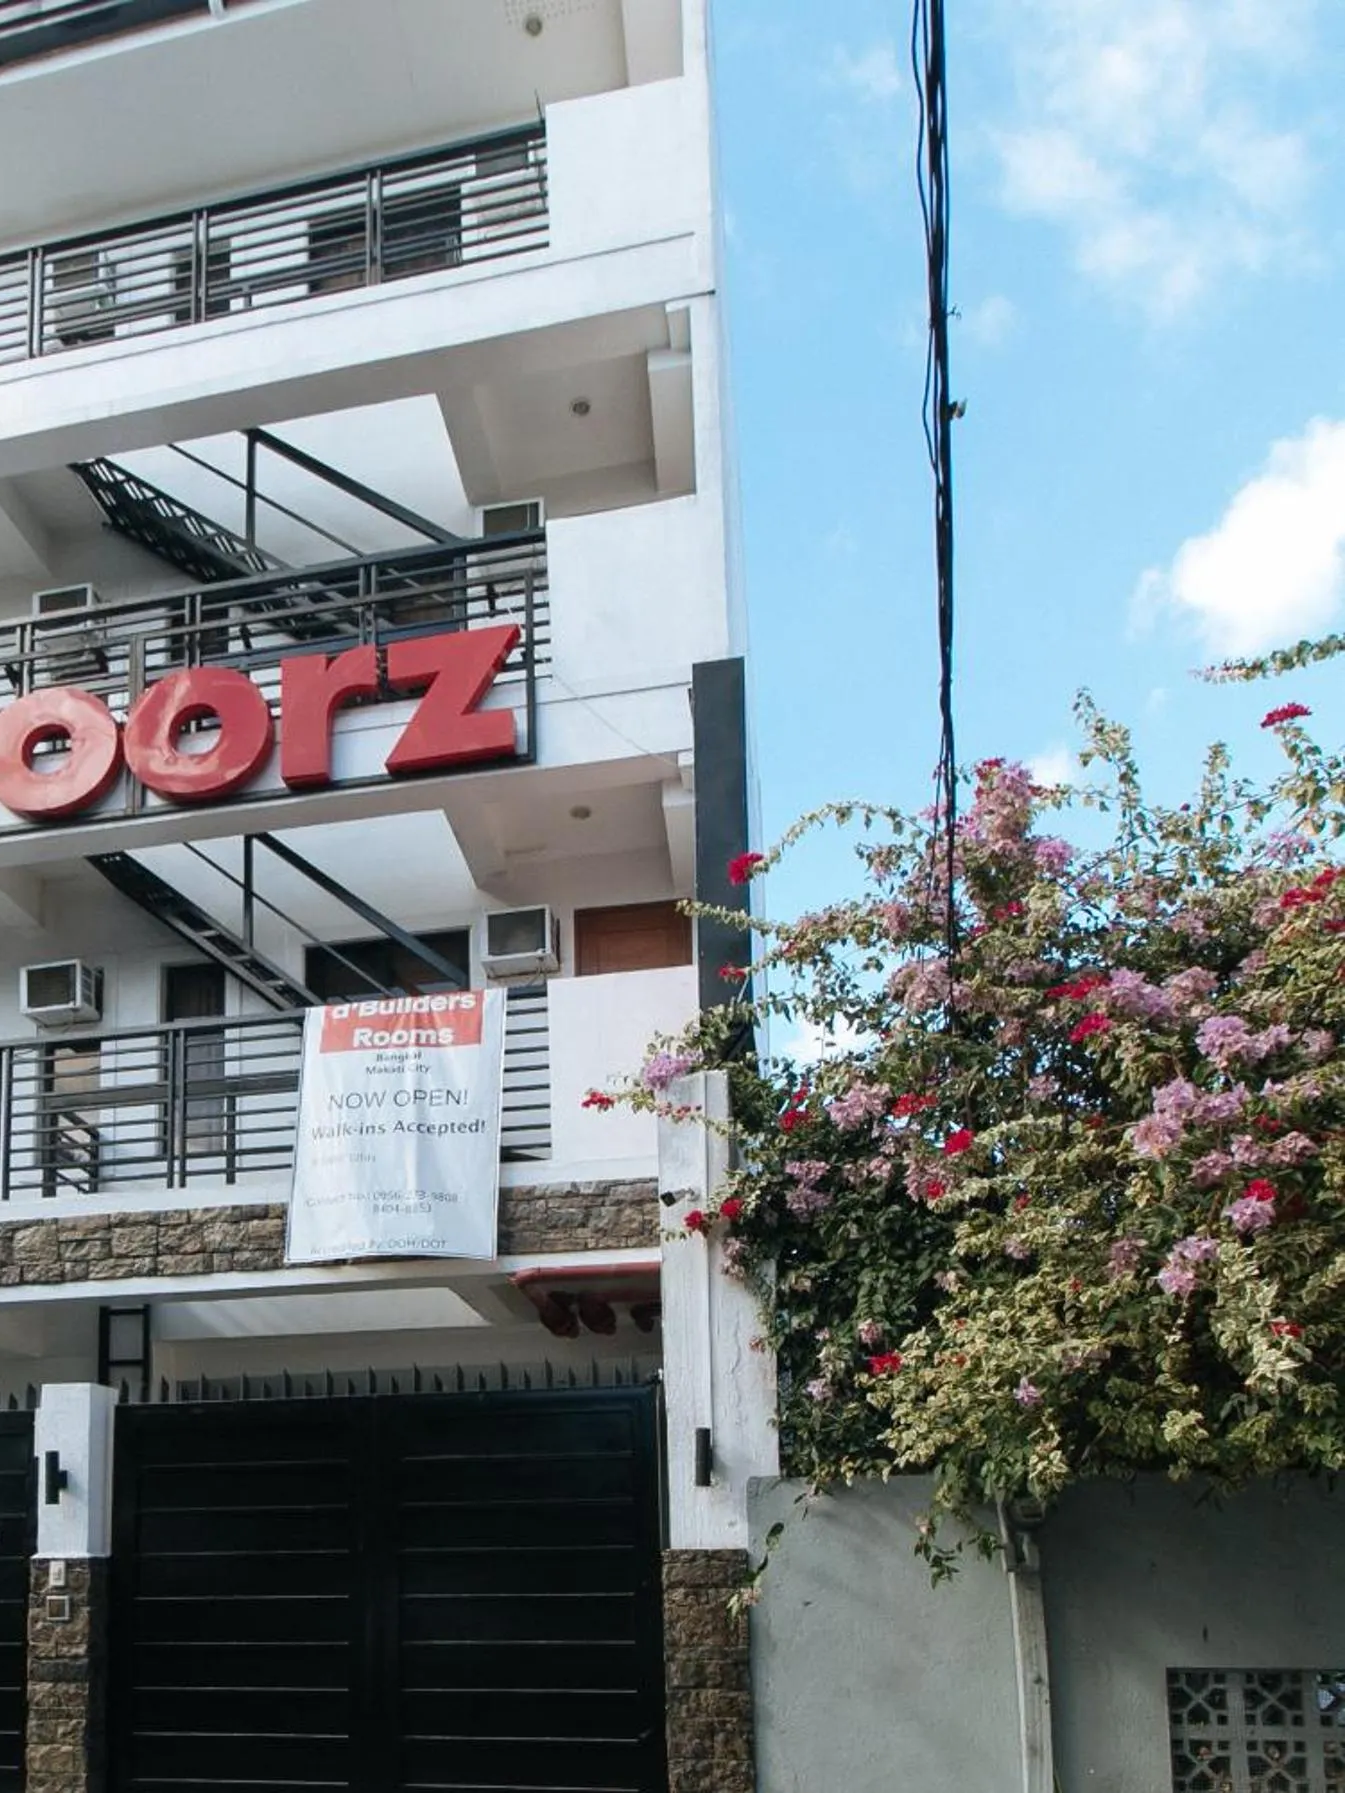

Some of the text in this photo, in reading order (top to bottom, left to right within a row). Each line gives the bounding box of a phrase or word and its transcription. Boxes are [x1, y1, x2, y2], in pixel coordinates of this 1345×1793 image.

[352, 1026, 454, 1048] Rooms
[329, 1089, 469, 1111] NOW OPEN!
[312, 1118, 486, 1142] Walk-ins Accepted!
